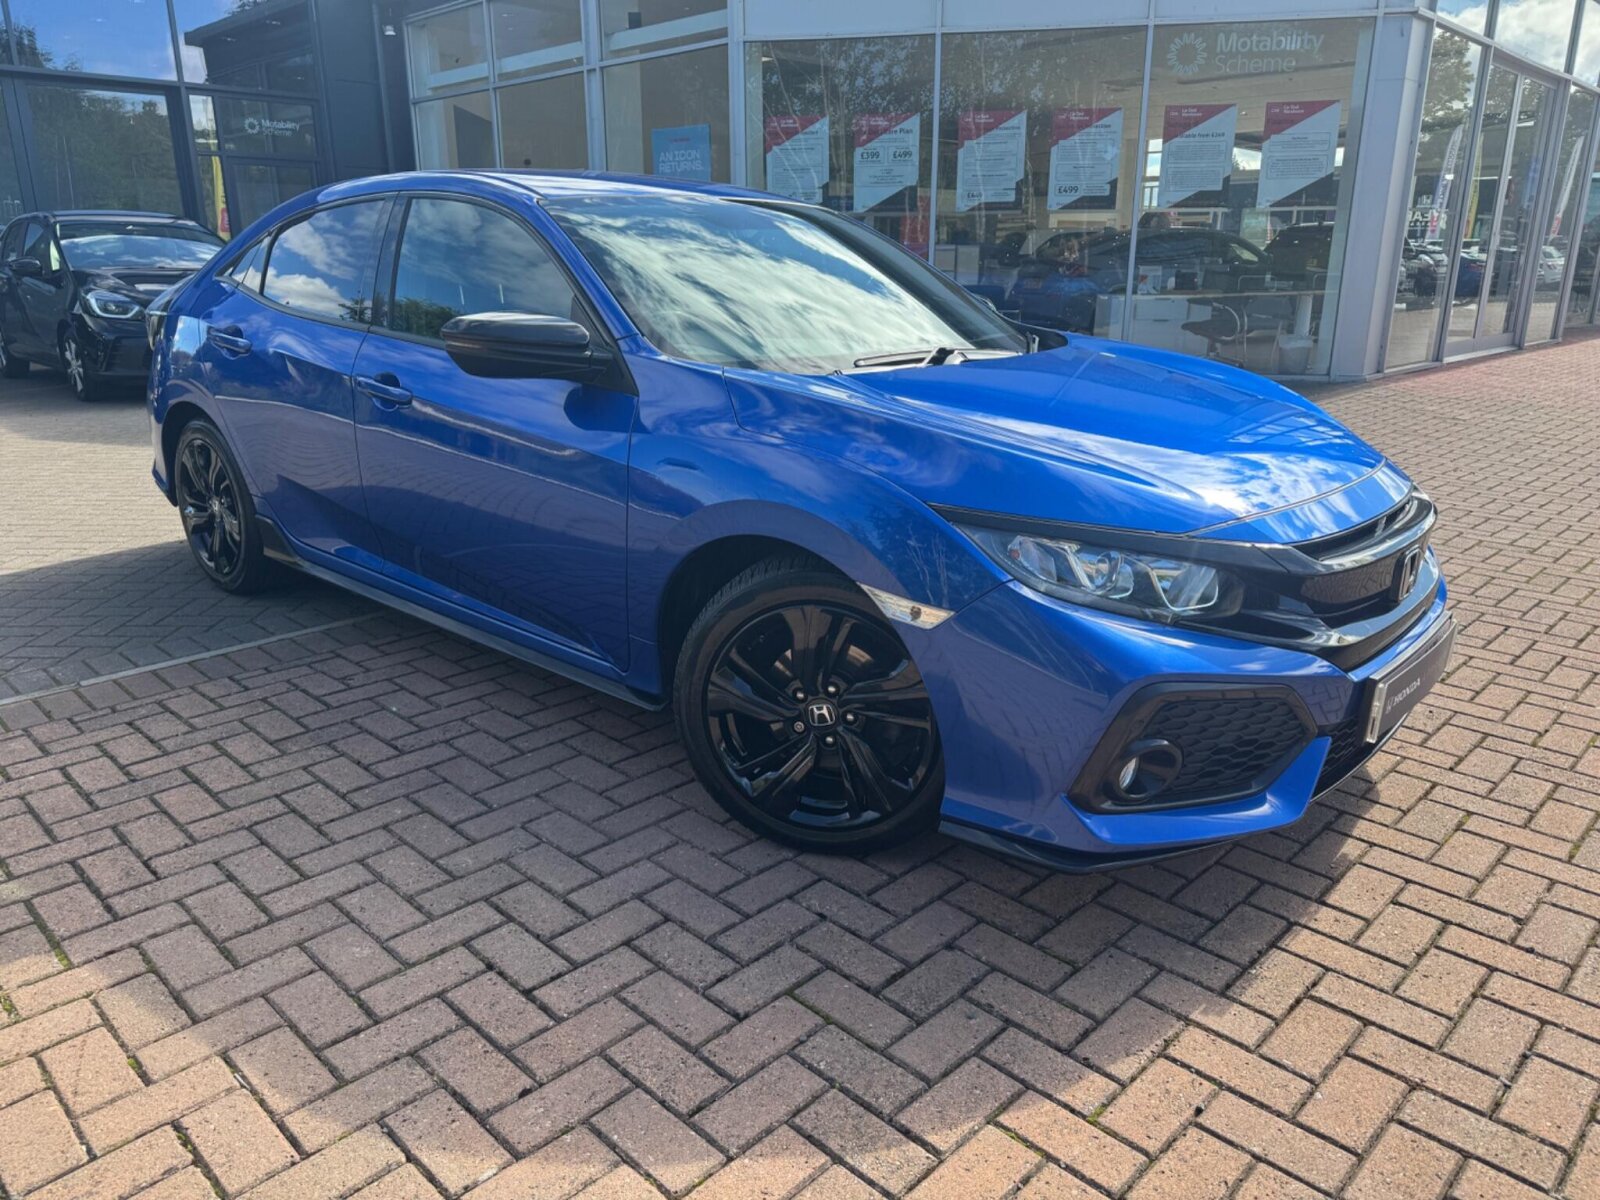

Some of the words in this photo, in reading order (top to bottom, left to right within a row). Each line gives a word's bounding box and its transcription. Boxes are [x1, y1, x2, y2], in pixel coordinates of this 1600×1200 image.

[1216, 30, 1325, 58] Motability
[1215, 54, 1297, 73] Scheme
[261, 119, 300, 131] Motability
[674, 149, 700, 160] ICON
[860, 151, 880, 160] £399
[1057, 185, 1079, 194] £499
[1393, 677, 1421, 706] HONDA
